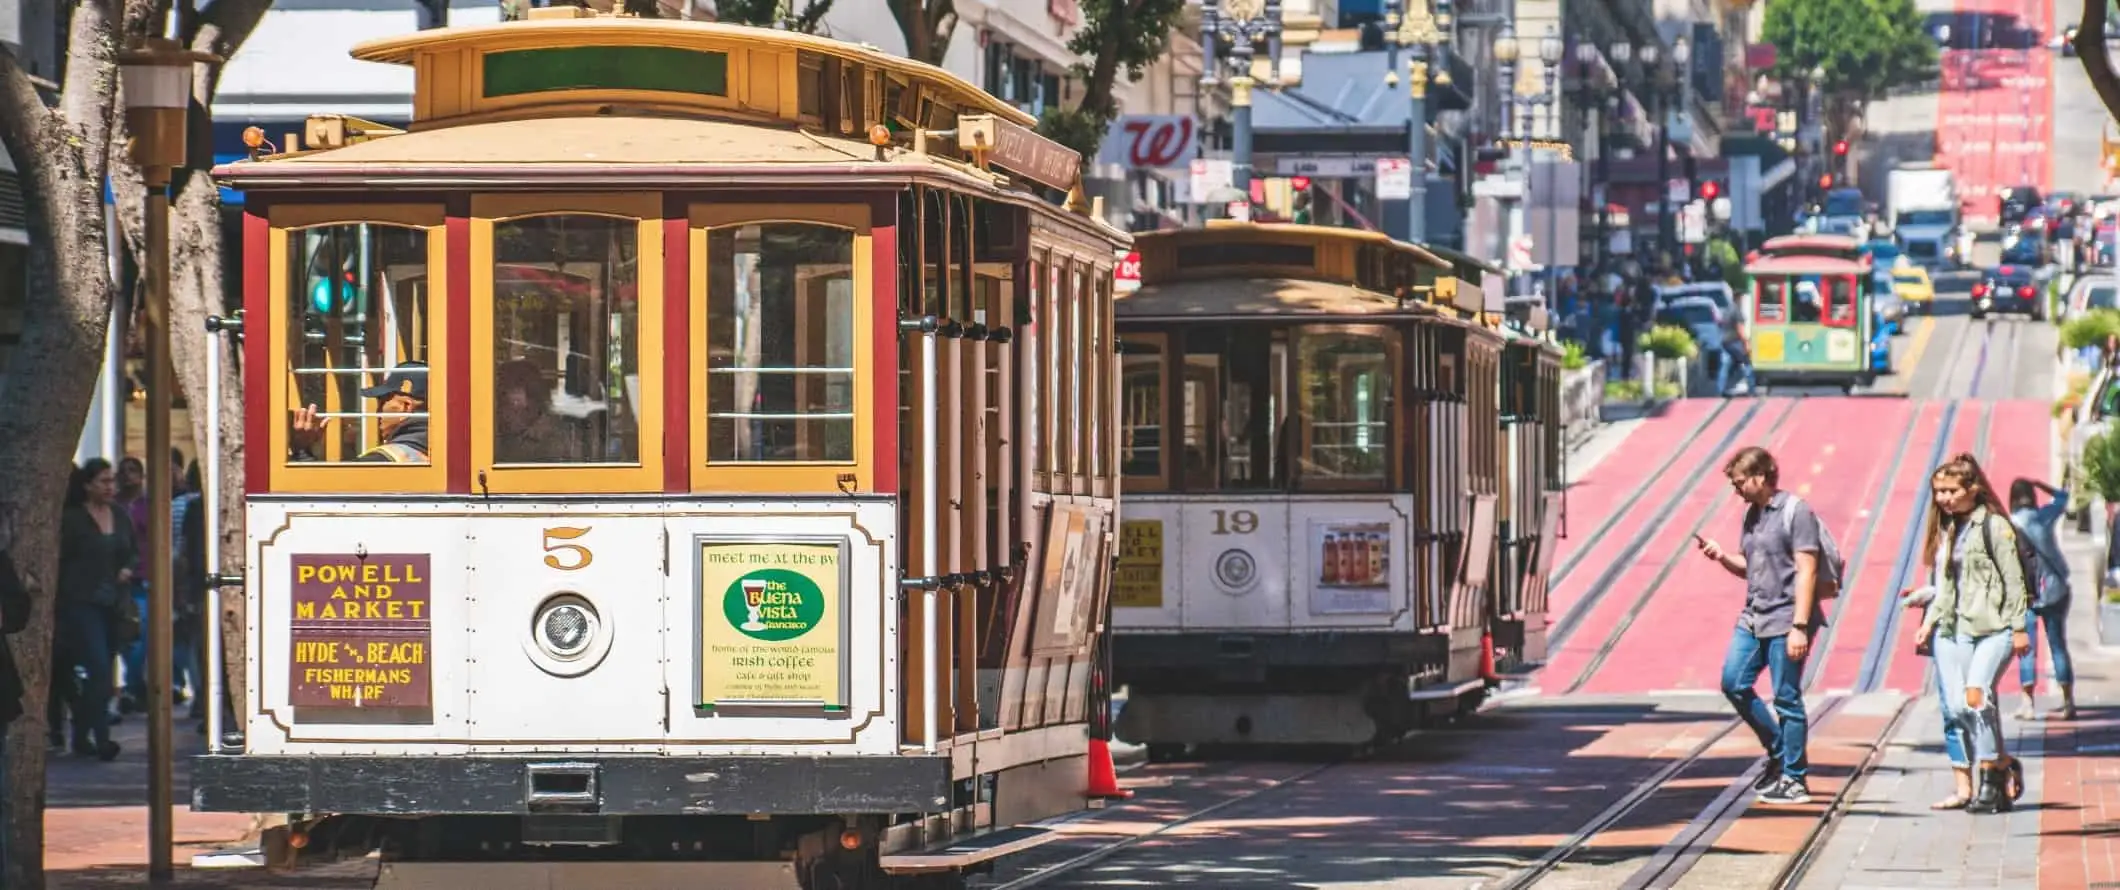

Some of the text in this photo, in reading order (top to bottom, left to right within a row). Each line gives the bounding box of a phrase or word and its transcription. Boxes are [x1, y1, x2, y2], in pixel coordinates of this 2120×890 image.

[1123, 117, 1193, 168] W
[1211, 509, 1260, 536] 19
[543, 526, 593, 571] 5
[709, 553, 745, 565] meet
[750, 554, 770, 565] me
[793, 553, 816, 565] the
[297, 564, 423, 584] POWELL
[331, 584, 393, 599] AND
[296, 600, 425, 620] MARKET
[295, 641, 424, 664] HYDE AND BEACH
[305, 668, 412, 684] FISHERMANS
